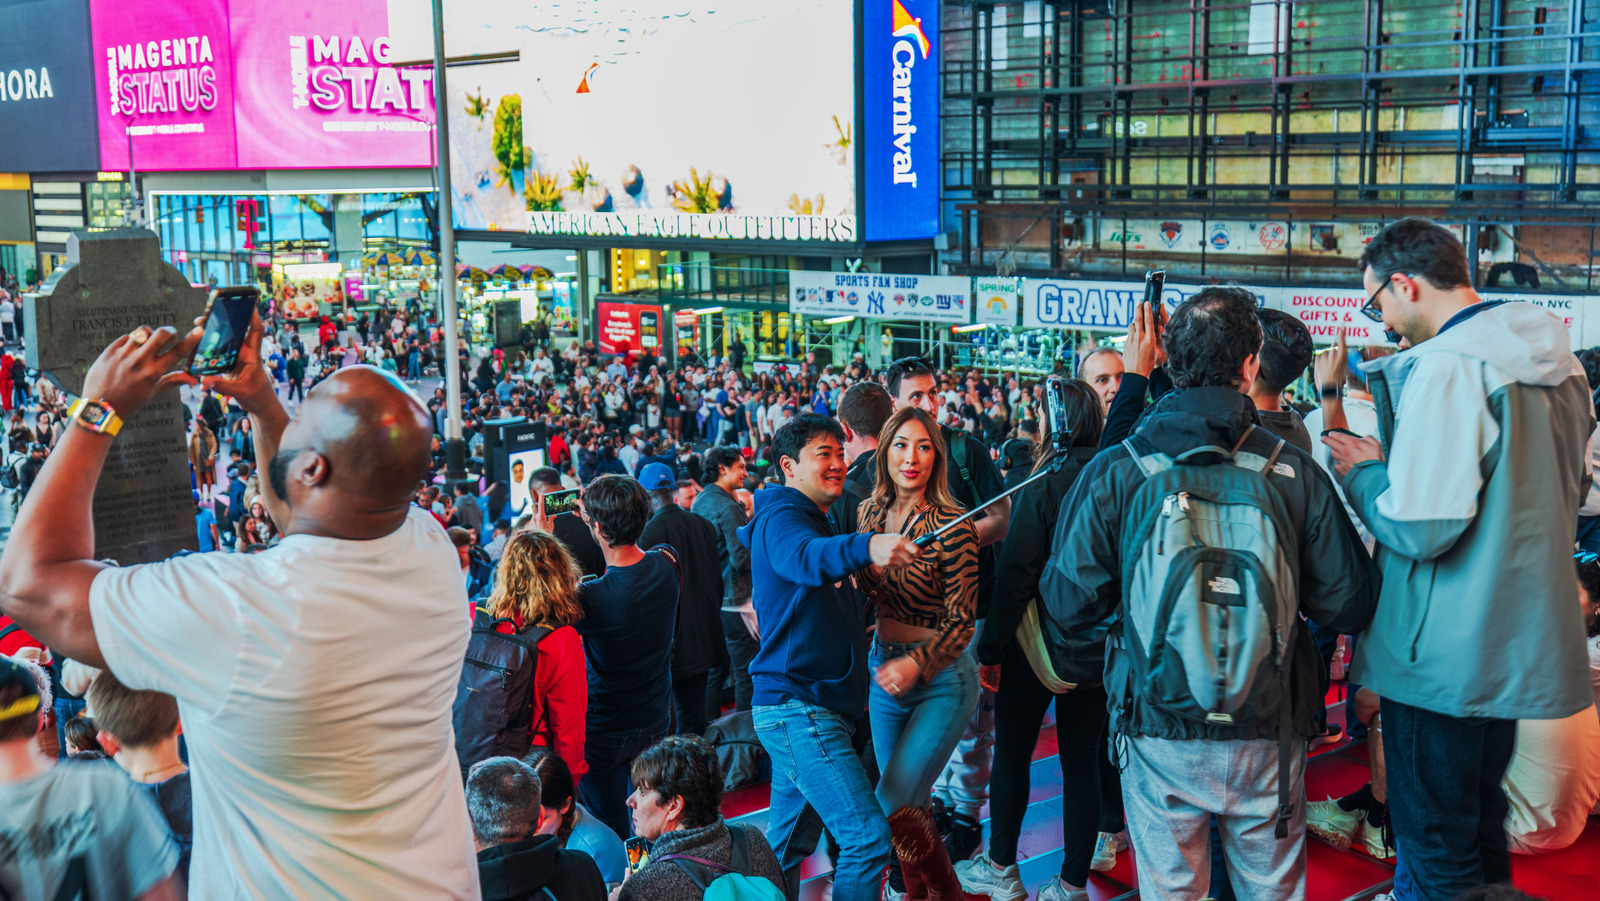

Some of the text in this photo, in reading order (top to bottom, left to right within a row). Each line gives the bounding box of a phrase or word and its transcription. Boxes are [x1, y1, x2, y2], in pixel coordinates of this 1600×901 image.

[117, 35, 213, 71] MAGENTA
[119, 65, 218, 115] STATUS
[312, 65, 435, 110] STAT
[892, 40, 917, 188] Carnival
[528, 213, 855, 242] AMERICAN EAGLE OUTFITTERS
[835, 274, 918, 289] SPORTS FAN SHOP
[1292, 296, 1367, 308] DISCOUNT
[1547, 300, 1572, 309] NYC
[72, 317, 123, 331] FRANCIS
[138, 313, 178, 325] DUFFY
[1300, 310, 1352, 322] GIFTS &
